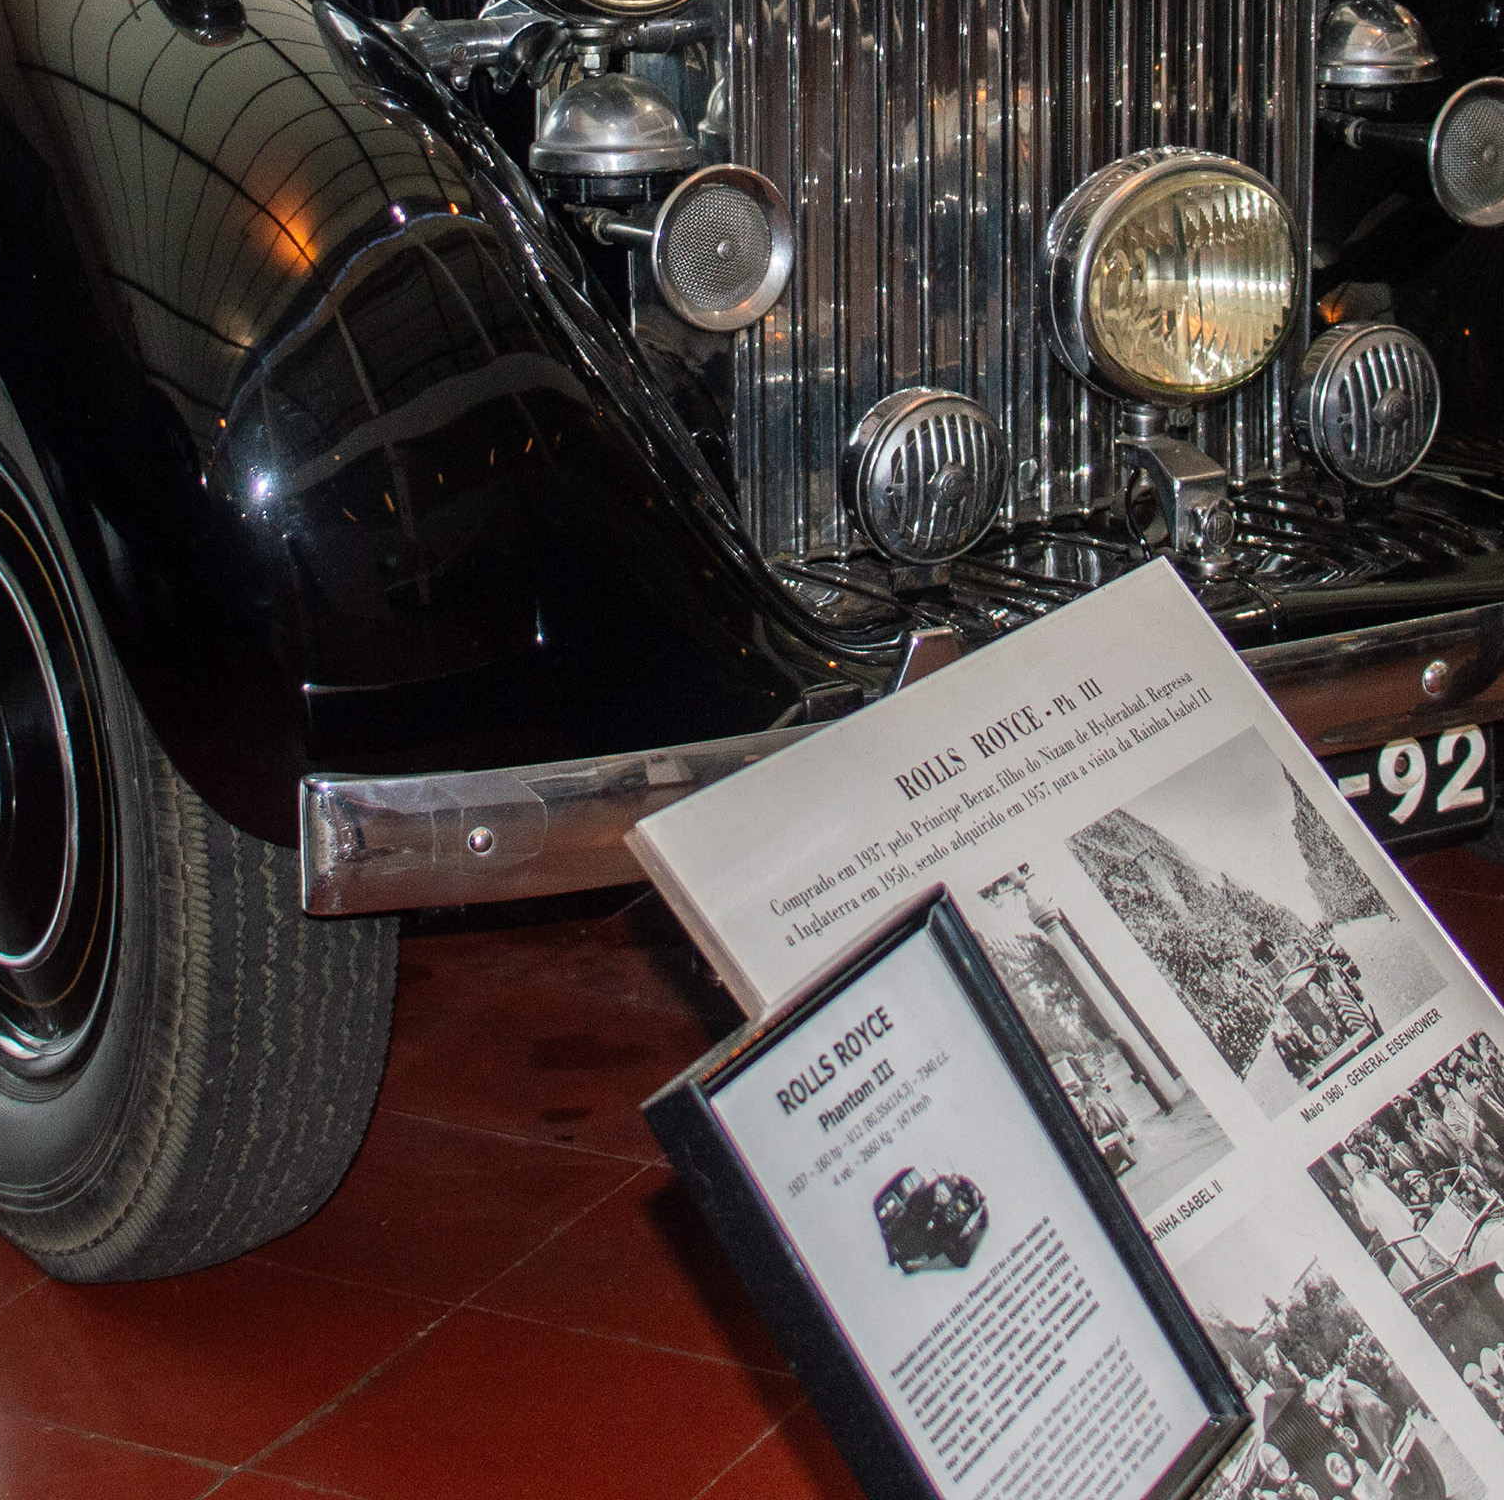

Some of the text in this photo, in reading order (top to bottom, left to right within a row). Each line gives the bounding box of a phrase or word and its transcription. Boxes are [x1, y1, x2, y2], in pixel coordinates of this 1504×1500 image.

[769, 873, 837, 917] Comprado
[837, 864, 858, 881] em
[853, 842, 887, 870] 1937
[887, 829, 914, 858] pelo
[910, 804, 963, 838] Príncipe
[995, 767, 1026, 789] filho
[1024, 757, 1042, 774] do
[1037, 739, 1077, 762] Nizam
[1074, 728, 1091, 745] de
[1145, 672, 1193, 703] Regressa
[894, 747, 967, 801] ROLLS
[970, 705, 1044, 759] ROYCE
[1052, 694, 1077, 716] Ph
[1077, 678, 1103, 702] III
[785, 934, 797, 947] a
[791, 898, 861, 941] Inglaterra
[860, 886, 881, 903] em
[914, 843, 950, 872] sendo
[950, 810, 1006, 851] adquirido
[1006, 802, 1025, 818] em
[1020, 780, 1052, 807] 1957
[1051, 770, 1080, 795] para
[1078, 765, 1089, 776] a
[1087, 747, 1119, 769] visita
[1116, 736, 1133, 753] da
[1128, 716, 1171, 744] Rainha
[1165, 693, 1201, 723] Isabel
[1196, 686, 1213, 705] II
[776, 1006, 894, 1116] ROLLS ROYCE
[817, 1058, 895, 1133] Phantom III
[1299, 1102, 1324, 1123] Maio
[1321, 1084, 1345, 1106] 1960
[1346, 1050, 1390, 1087] GENERAL
[1385, 1008, 1443, 1057] EISENHOWER
[1176, 1187, 1216, 1221] ISABEL
[1211, 1179, 1224, 1194] II
